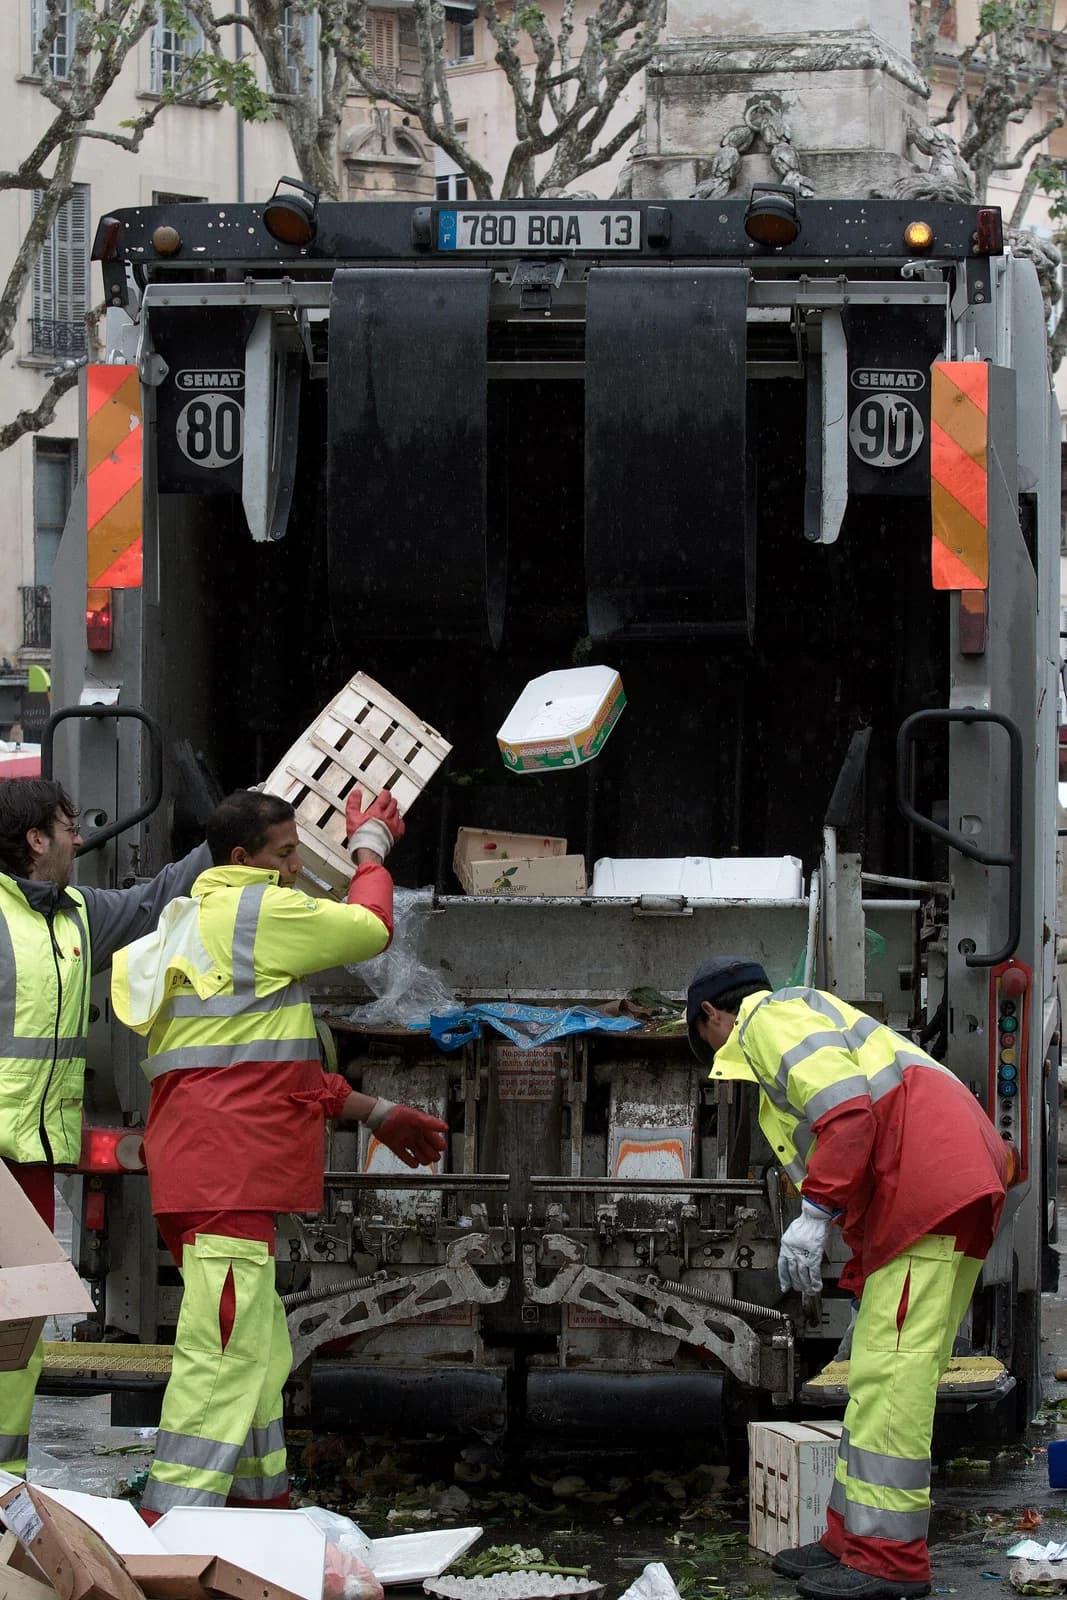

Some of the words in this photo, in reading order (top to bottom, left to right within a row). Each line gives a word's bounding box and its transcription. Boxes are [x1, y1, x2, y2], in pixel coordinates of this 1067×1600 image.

[443, 233, 451, 243] F
[463, 215, 516, 246] 780
[528, 215, 582, 246] BQA
[599, 215, 632, 246] 13
[183, 373, 241, 387] SEMAT
[858, 372, 918, 387] SEMAT
[186, 401, 241, 460] 80
[858, 400, 914, 460] 90
